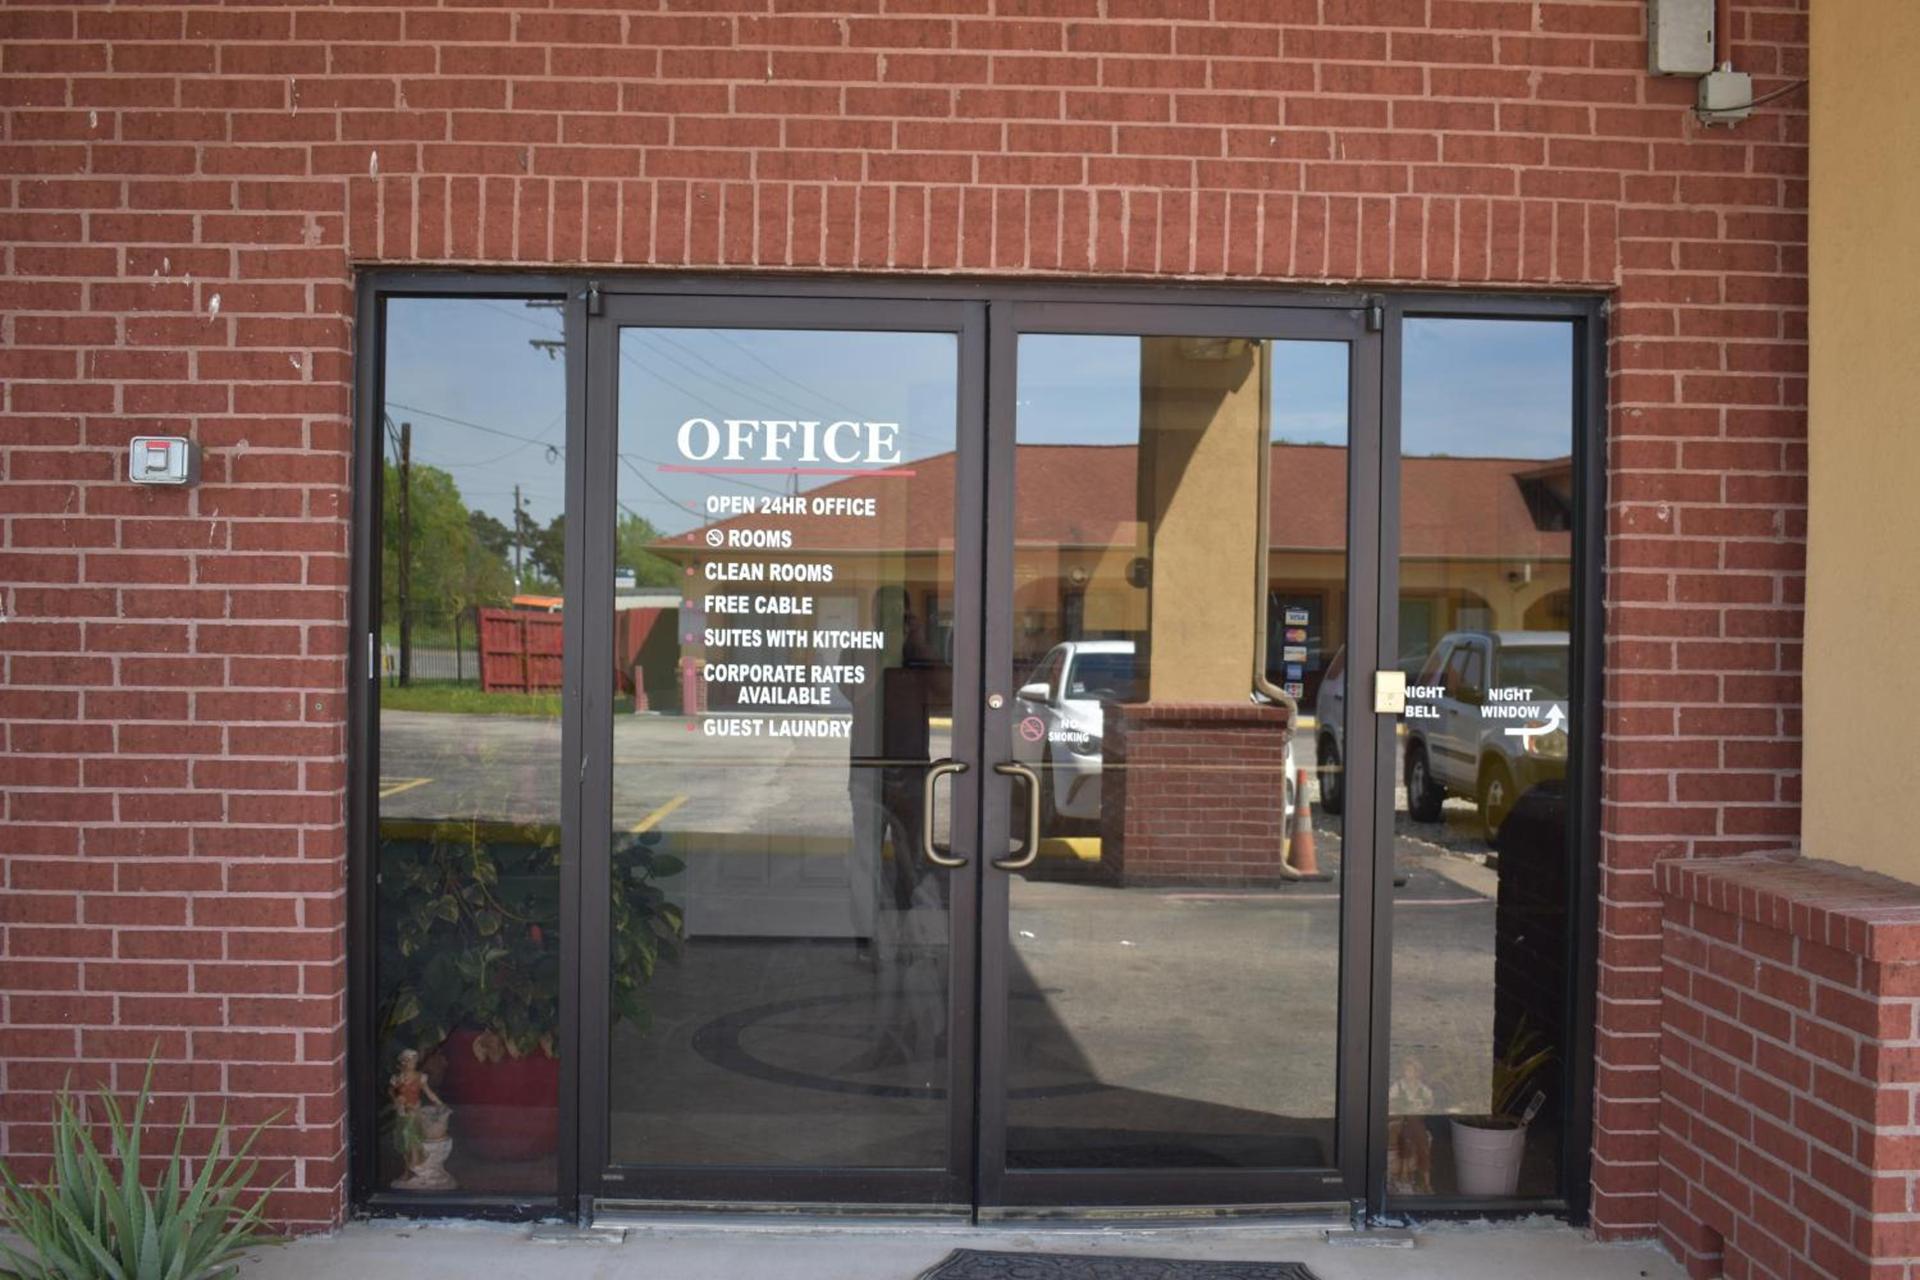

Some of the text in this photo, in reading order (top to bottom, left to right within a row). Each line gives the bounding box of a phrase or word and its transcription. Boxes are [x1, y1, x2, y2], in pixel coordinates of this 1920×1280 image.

[677, 418, 901, 464] OFFICE
[706, 495, 876, 516] OPEN 24HR OFFICE
[728, 529, 792, 548] ROOMS
[705, 562, 833, 582] CLEAN ROOMS
[704, 595, 812, 615] FREE CABLE
[704, 629, 884, 649] SUITES WITH KITCHEN
[703, 664, 865, 684] CORPORATE RATES
[738, 686, 831, 705] AVAILABLE
[1404, 686, 1446, 699] NIGHT
[1488, 688, 1533, 701] NIGHT
[1405, 706, 1440, 718] BELL
[1480, 706, 1540, 718] WINDOW
[703, 718, 853, 738] GUEST LAUNDRY
[1061, 719, 1079, 729] NO
[1048, 732, 1089, 742] SMOKING
